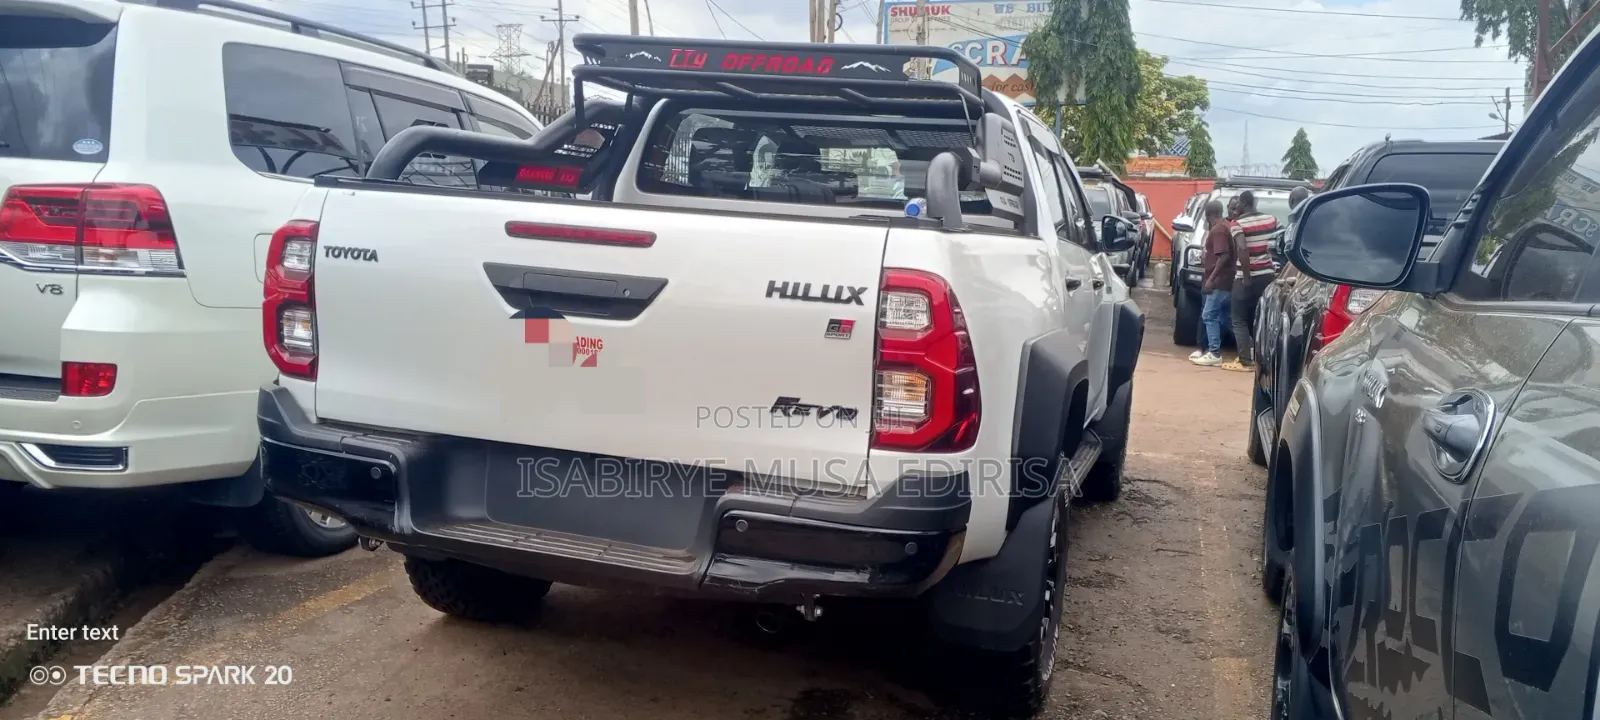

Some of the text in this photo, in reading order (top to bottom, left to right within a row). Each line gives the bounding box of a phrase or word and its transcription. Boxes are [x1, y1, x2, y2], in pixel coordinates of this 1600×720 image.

[721, 53, 835, 74] OFFROAD
[323, 245, 379, 263] TOYOTA
[36, 282, 64, 296] V8
[765, 280, 868, 306] HILUX
